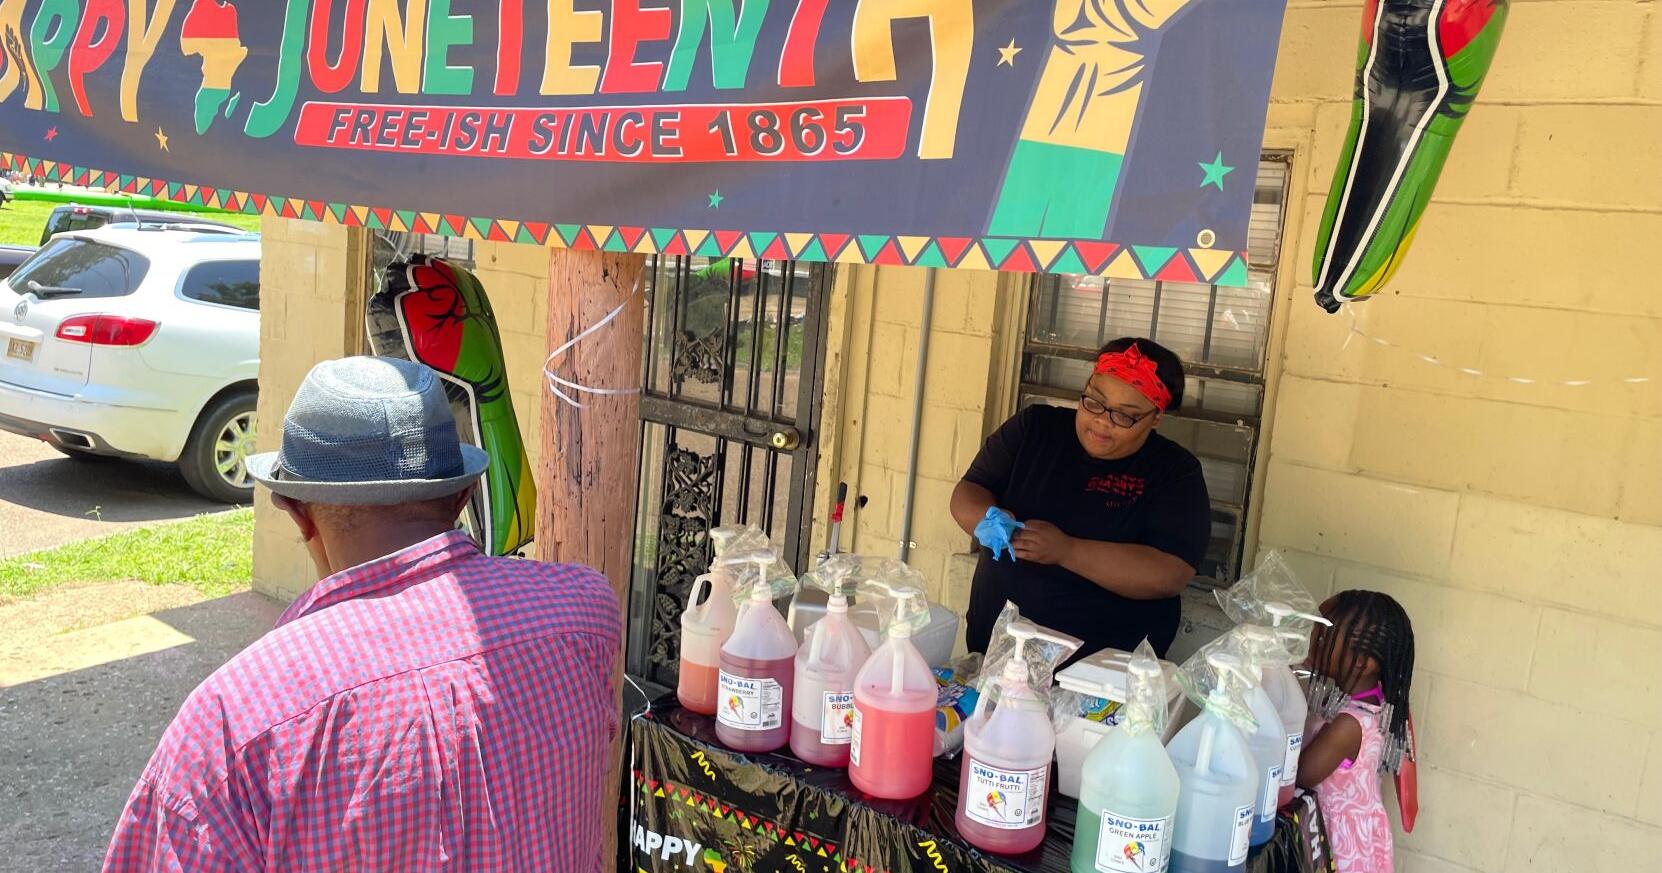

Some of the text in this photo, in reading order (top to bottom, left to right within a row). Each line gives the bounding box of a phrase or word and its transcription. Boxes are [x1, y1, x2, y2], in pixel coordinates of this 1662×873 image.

[326, 104, 867, 157] FREE-ISH SINCE 1865
[720, 675, 756, 690] SNO-BAL
[973, 766, 1023, 785] SNO-BAL
[976, 775, 1021, 792] TUTTI FRUTTI
[1107, 817, 1161, 832] SNO-BAL
[1108, 827, 1134, 839] GREEN
[633, 820, 702, 867] APPY
